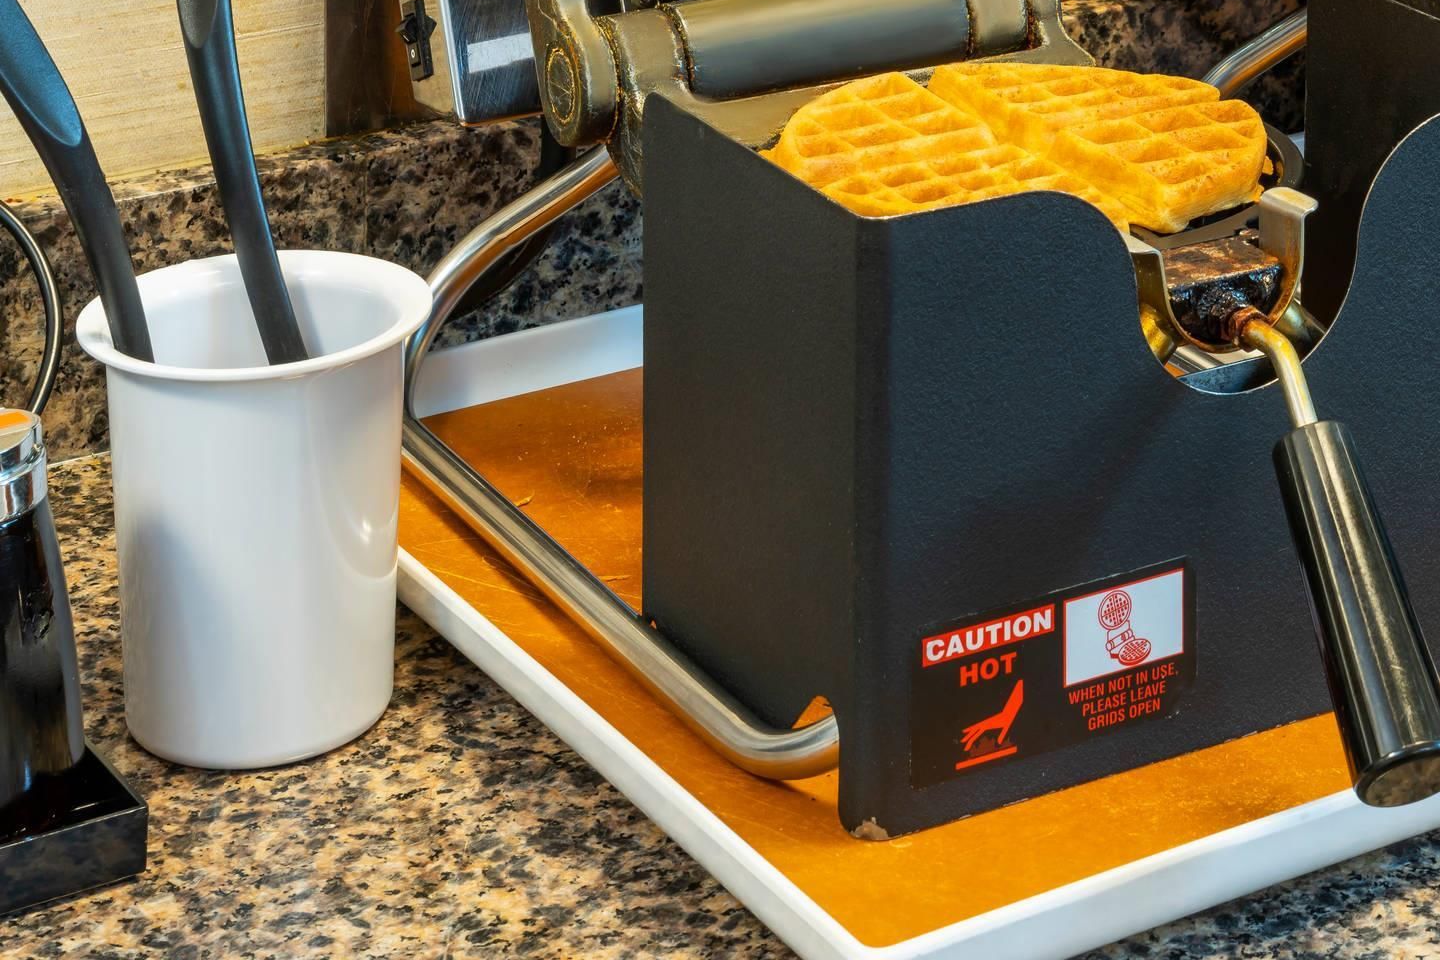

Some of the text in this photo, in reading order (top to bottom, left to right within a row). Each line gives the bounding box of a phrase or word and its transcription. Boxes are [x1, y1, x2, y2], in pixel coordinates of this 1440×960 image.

[926, 608, 1052, 662] CAUTION
[960, 651, 1017, 687] HOT
[1068, 683, 1105, 705] WHEN
[1108, 674, 1133, 694] NOT
[1136, 670, 1148, 685] IN
[1082, 680, 1167, 717] PLEASE LEAVE
[1087, 698, 1161, 731] GRIDS OPEN
